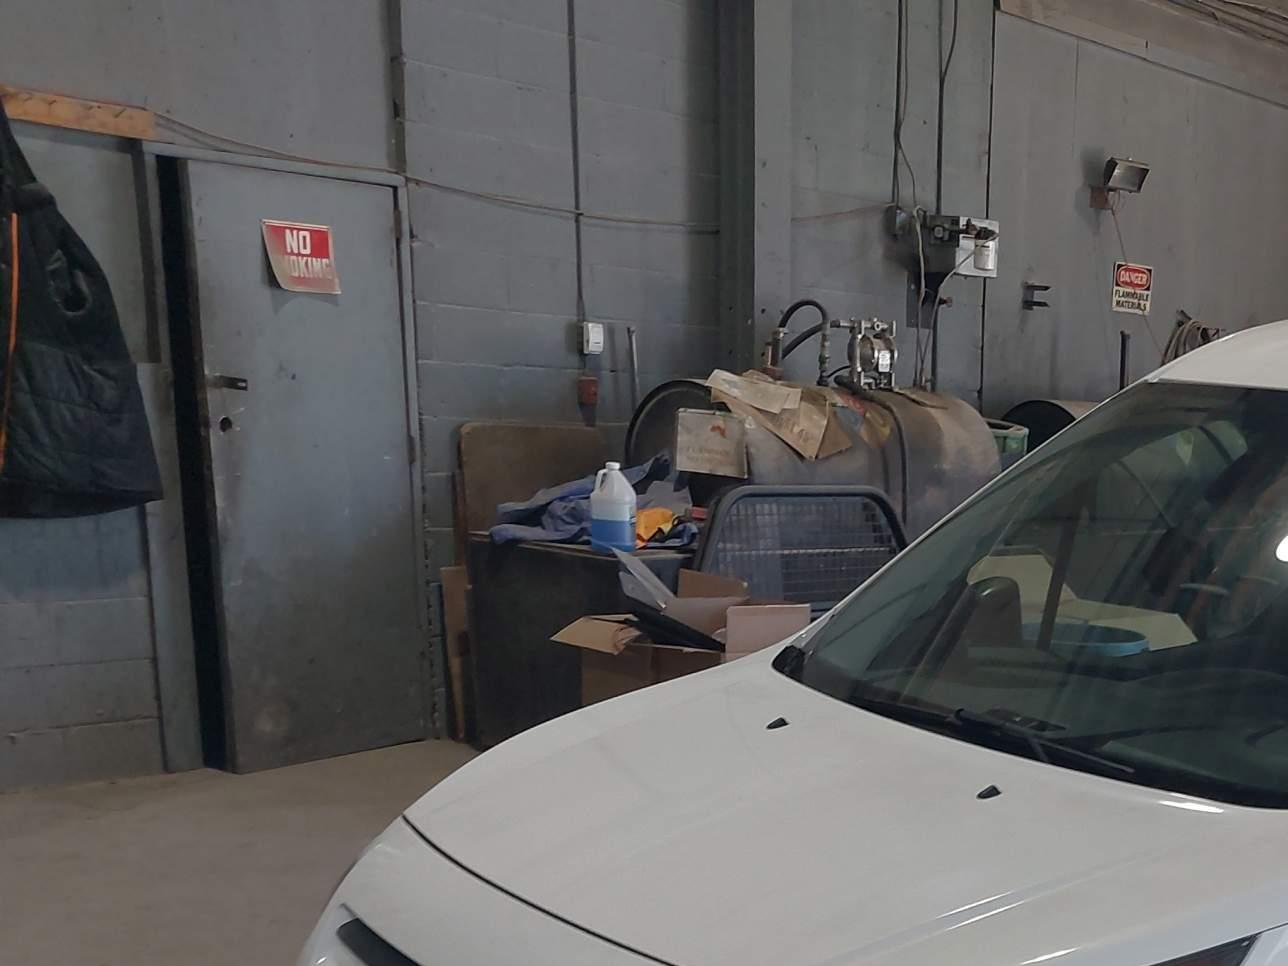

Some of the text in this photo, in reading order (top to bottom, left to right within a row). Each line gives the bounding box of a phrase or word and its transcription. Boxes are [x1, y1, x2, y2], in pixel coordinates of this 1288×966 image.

[285, 229, 311, 254] NO
[279, 254, 333, 279] OKING
[1120, 270, 1148, 285] DANGER
